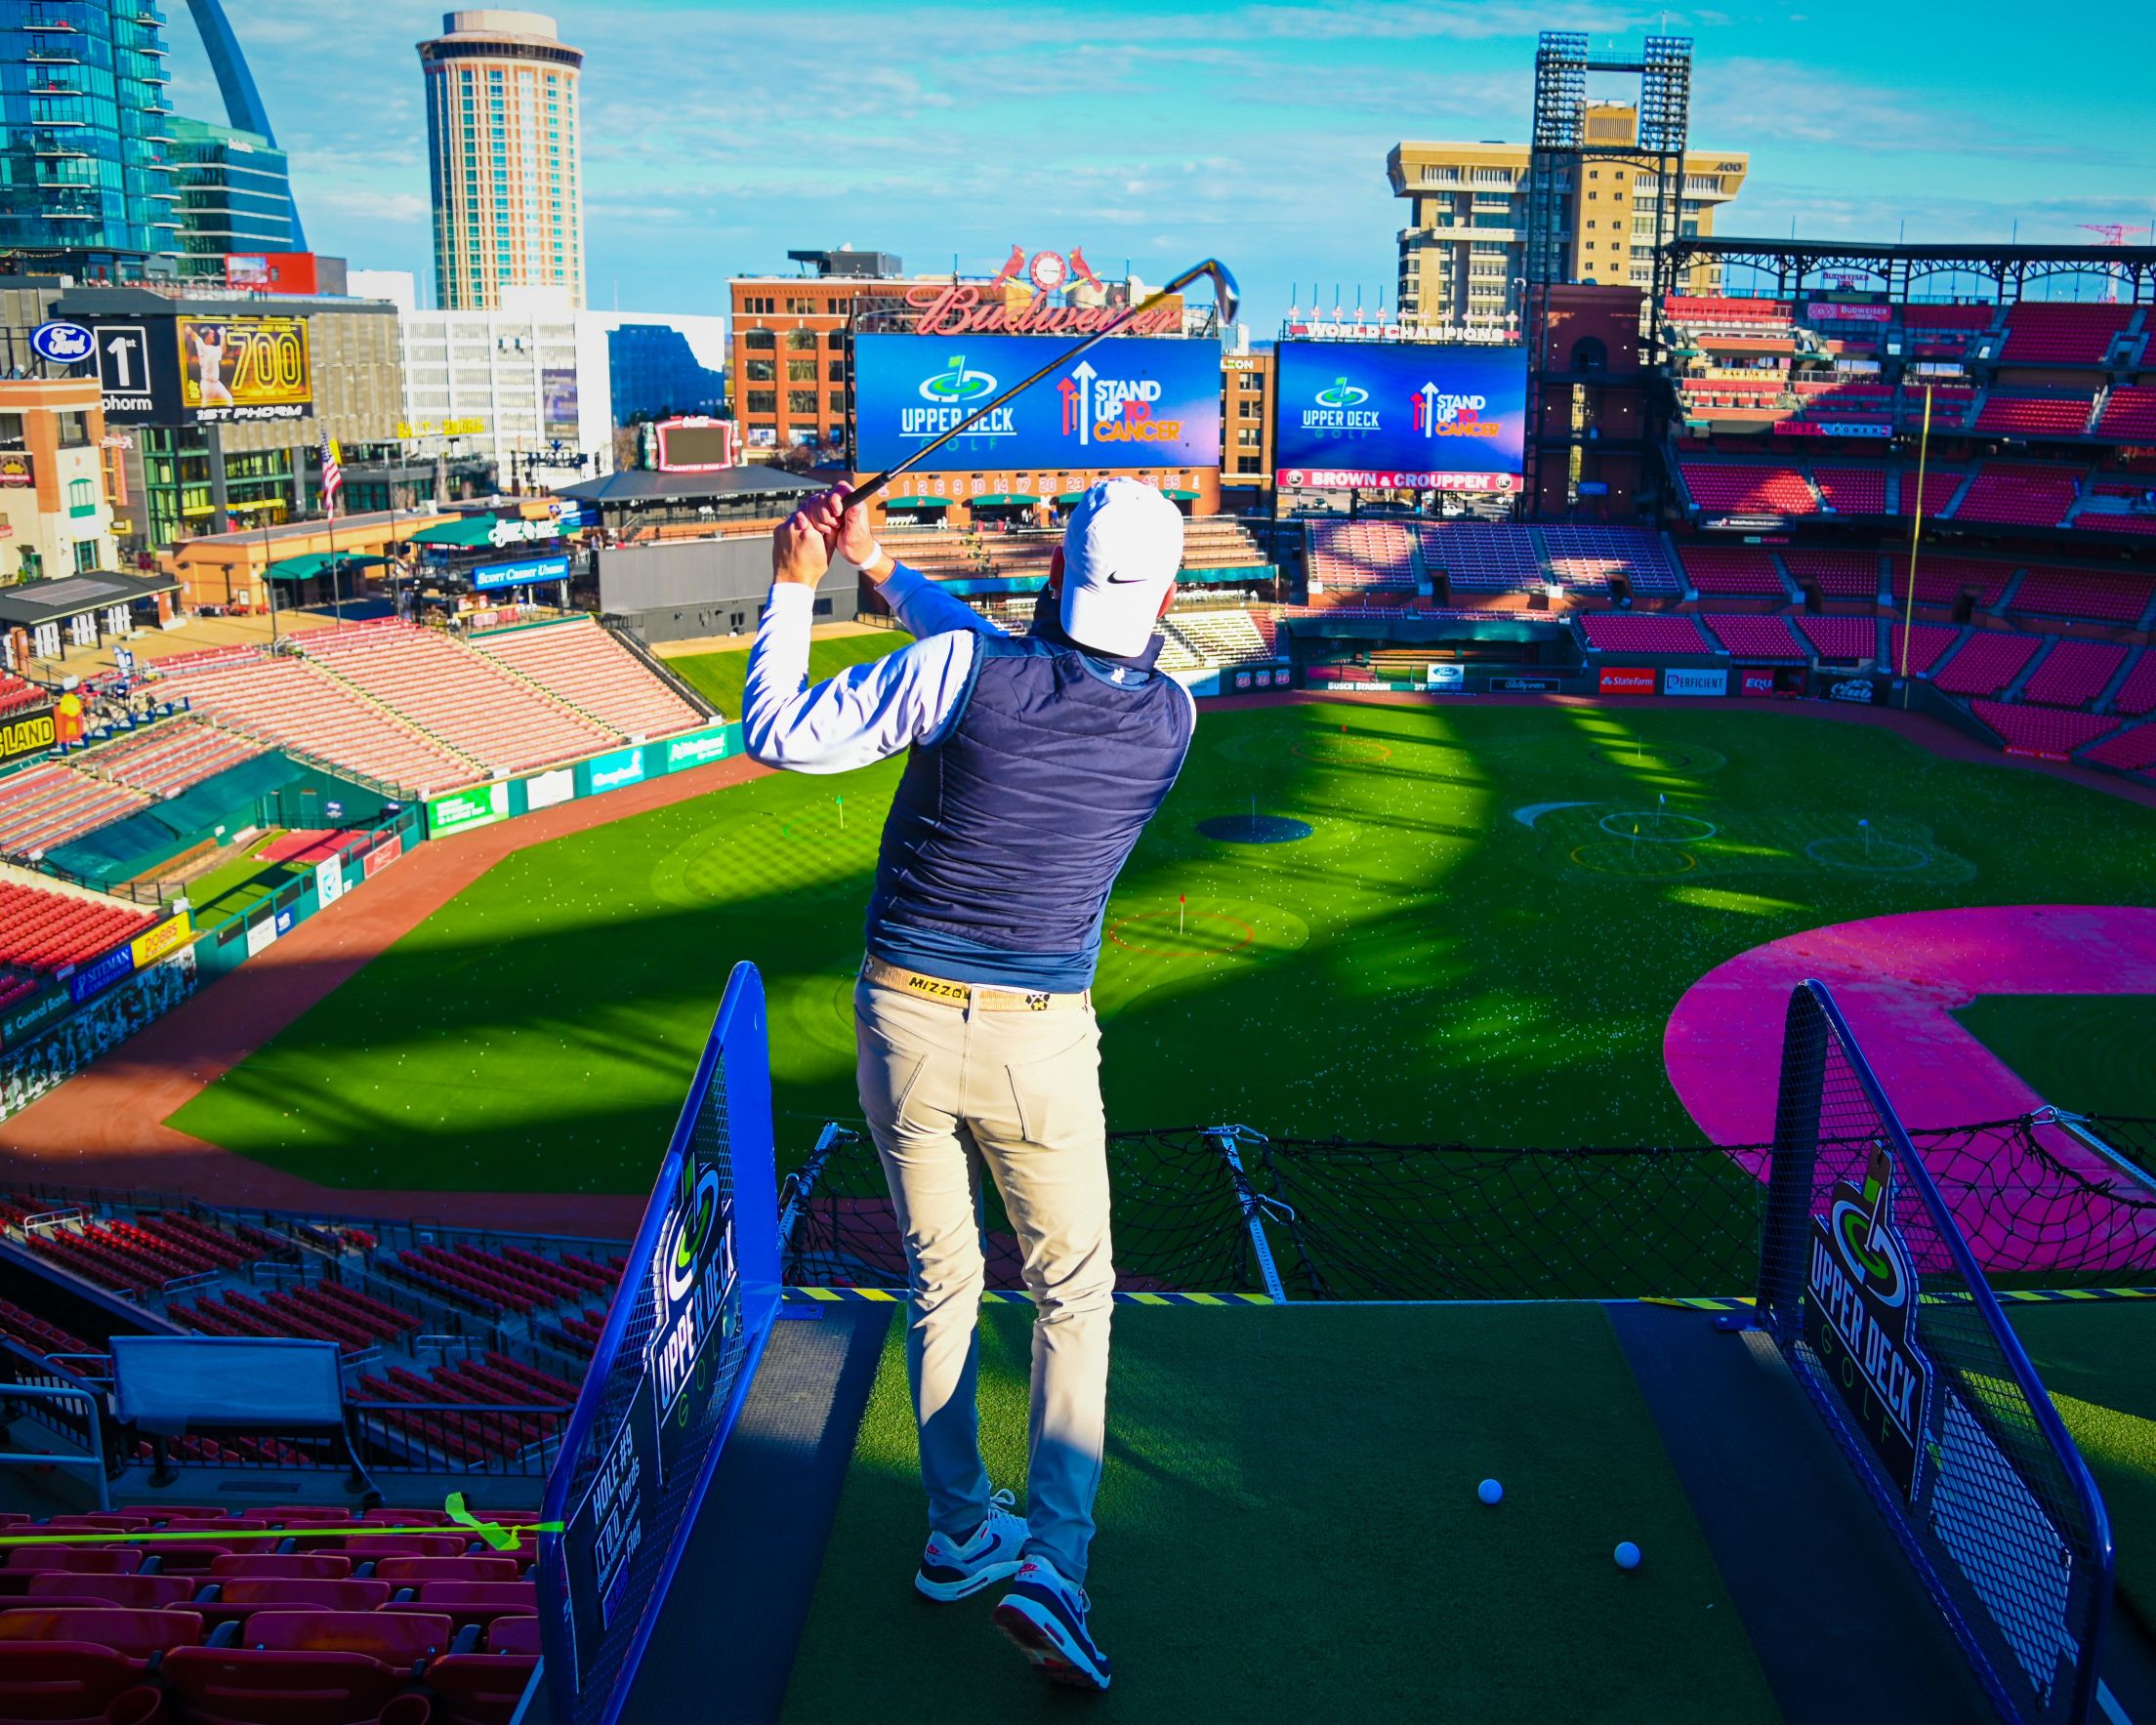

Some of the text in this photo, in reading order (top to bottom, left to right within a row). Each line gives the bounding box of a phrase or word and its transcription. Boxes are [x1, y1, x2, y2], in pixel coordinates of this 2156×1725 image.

[1306, 323, 1506, 342] WORLD CHAMPIONS
[227, 332, 302, 390] 700
[1095, 380, 1161, 401] STAND
[102, 395, 153, 414] phorm
[1436, 394, 1486, 410] STAND
[196, 405, 303, 421] 1ST PHORM
[902, 408, 1014, 432] UPPER DECK
[1303, 410, 1380, 428] UPPER DECK
[1094, 421, 1180, 442] CANCER
[1314, 430, 1369, 439] GOLF
[1435, 422, 1500, 437] CANCER
[903, 481, 911, 496] 1
[918, 481, 928, 496] 2
[934, 480, 945, 495] 6
[953, 479, 963, 495] 9
[972, 479, 985, 494] 10
[994, 478, 1009, 494] 14
[1016, 478, 1031, 493] 17
[1040, 478, 1056, 493] 20
[1066, 478, 1084, 492] 23
[1164, 475, 1181, 490] 85
[1311, 472, 1378, 486] BROWN
[1381, 476, 1390, 486] &
[1393, 472, 1491, 488] CROUPPEN
[1613, 676, 1654, 686] StateFarm
[1667, 674, 1723, 689] PERFICIENT
[145, 923, 178, 953] DOBBS
[86, 948, 131, 982] SITEMAN
[16, 989, 71, 1030] Central Bank
[659, 1220, 734, 1411] UPPER DECK
[1811, 1236, 1916, 1432] UPPER DECK
[1821, 1323, 1890, 1444] GOLF
[593, 1453, 619, 1525] HOLE
[620, 1422, 633, 1473] #9
[619, 1456, 641, 1510] Yards
[626, 1517, 642, 1564] Flag
